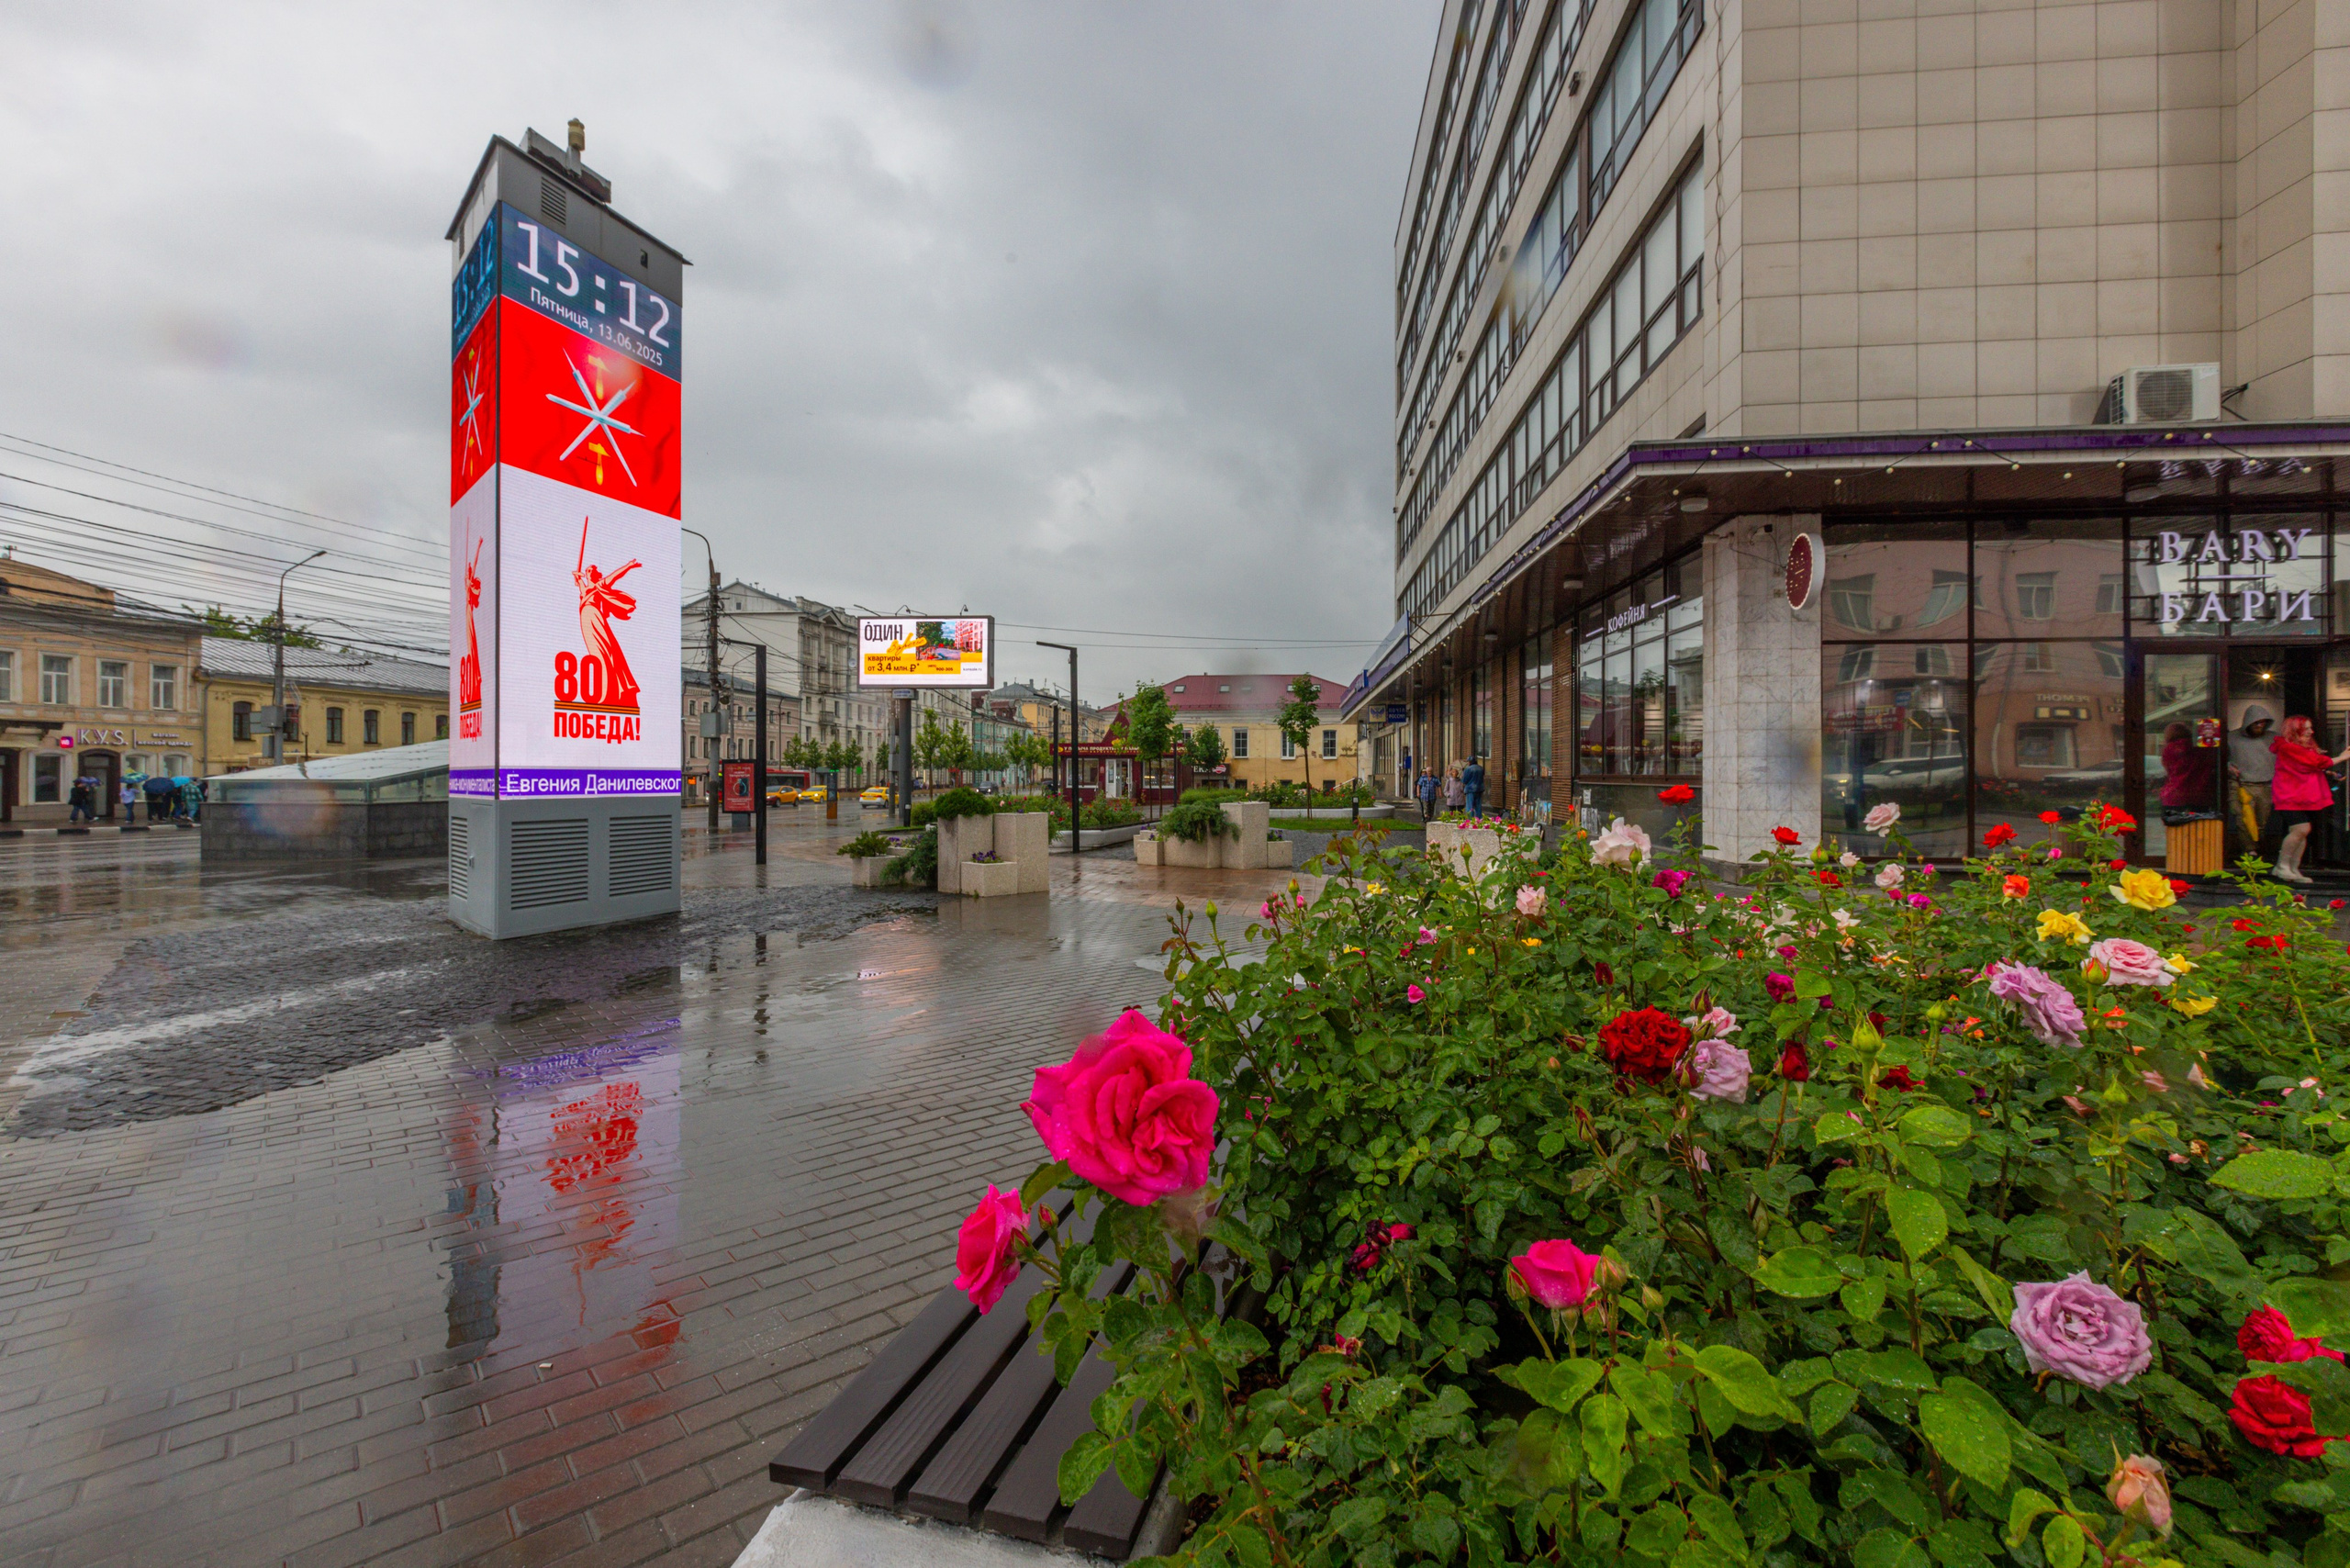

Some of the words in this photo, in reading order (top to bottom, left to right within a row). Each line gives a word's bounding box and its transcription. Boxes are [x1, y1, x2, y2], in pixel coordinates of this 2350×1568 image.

[518, 221, 669, 349] 15:12
[531, 286, 593, 333] Пятница,
[599, 323, 663, 366] 13.06.2025
[2160, 529, 2312, 562] BARY
[1607, 603, 1646, 633] КОФЕЙНЯ
[2161, 589, 2314, 622] БАРИ
[460, 654, 474, 704] 80
[554, 651, 603, 704] 80
[877, 663, 891, 672] 3,4
[460, 711, 482, 742] ПОБЕДА!
[554, 711, 641, 744] ПОБЕДА!
[507, 773, 580, 795] Евгения
[585, 774, 681, 795] Данилевског
